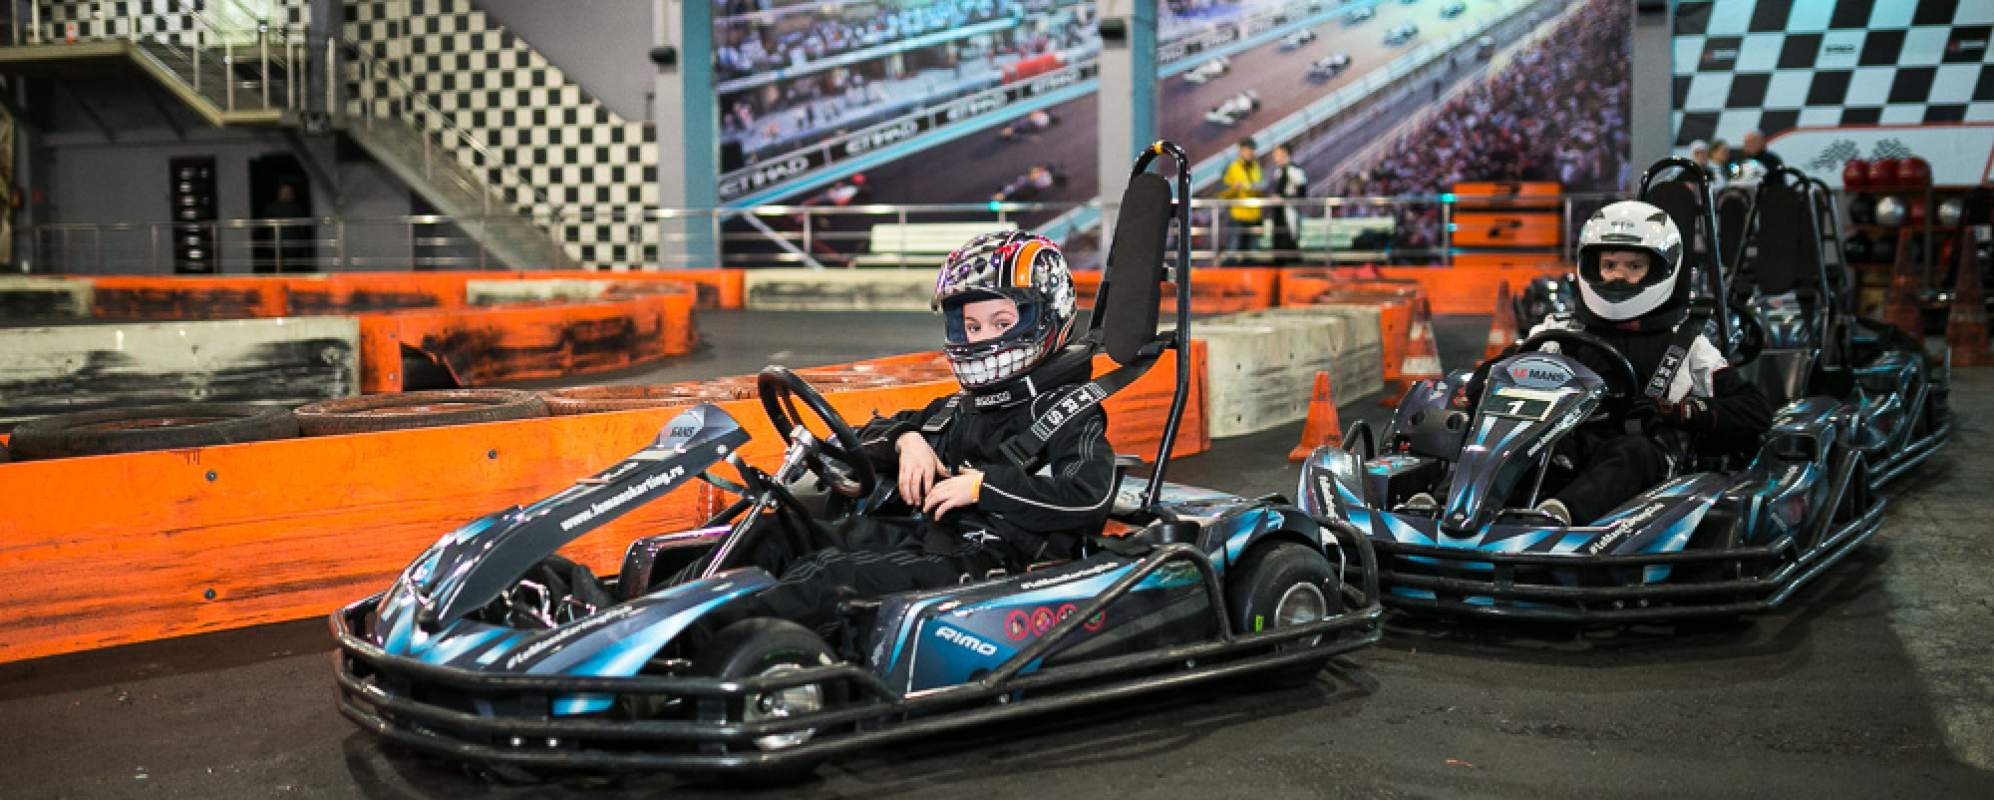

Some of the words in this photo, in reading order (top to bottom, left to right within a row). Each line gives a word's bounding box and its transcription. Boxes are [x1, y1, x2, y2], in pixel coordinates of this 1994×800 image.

[846, 119, 918, 153] ETIHAD
[719, 156, 809, 195] ETIHAD
[1512, 368, 1528, 378] LE
[1529, 368, 1567, 382] MANS
[1507, 400, 1526, 416] 1
